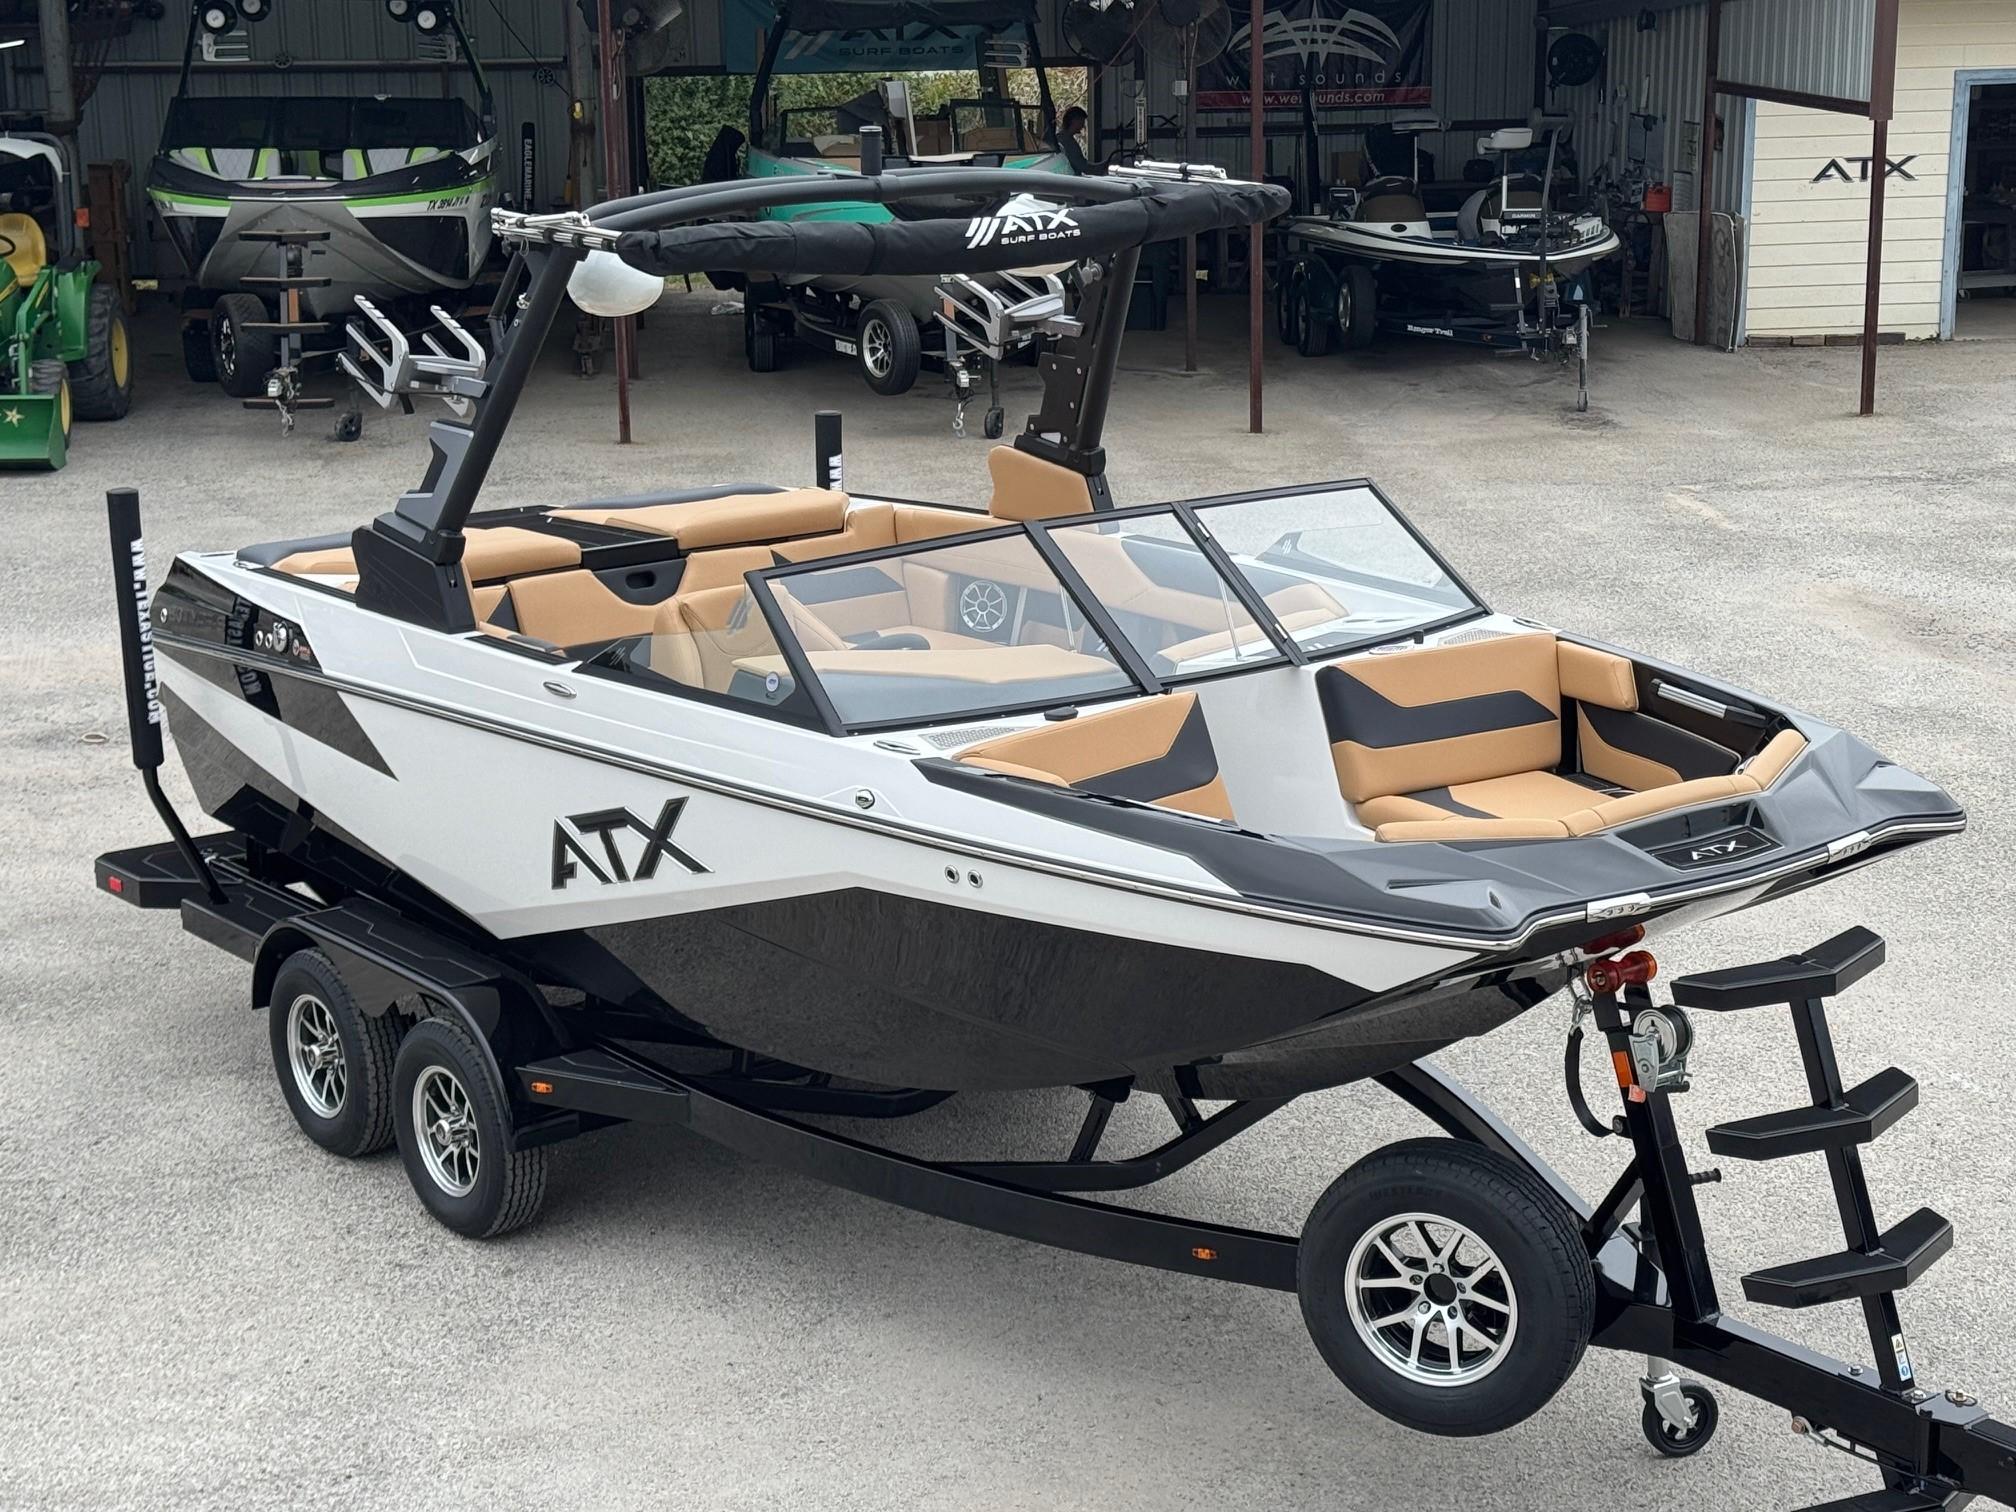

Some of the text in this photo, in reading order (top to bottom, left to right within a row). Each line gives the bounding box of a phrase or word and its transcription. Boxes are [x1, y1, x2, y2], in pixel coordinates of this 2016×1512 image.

[839, 45, 965, 57] SURF BOATS
[1225, 69, 1402, 86] wt sounds
[1809, 154, 1919, 183] ATX
[1001, 208, 1079, 235] ATX
[1001, 229, 1081, 245] SURF BOATS
[551, 796, 716, 890] ATX
[1691, 840, 1749, 861] ATX
